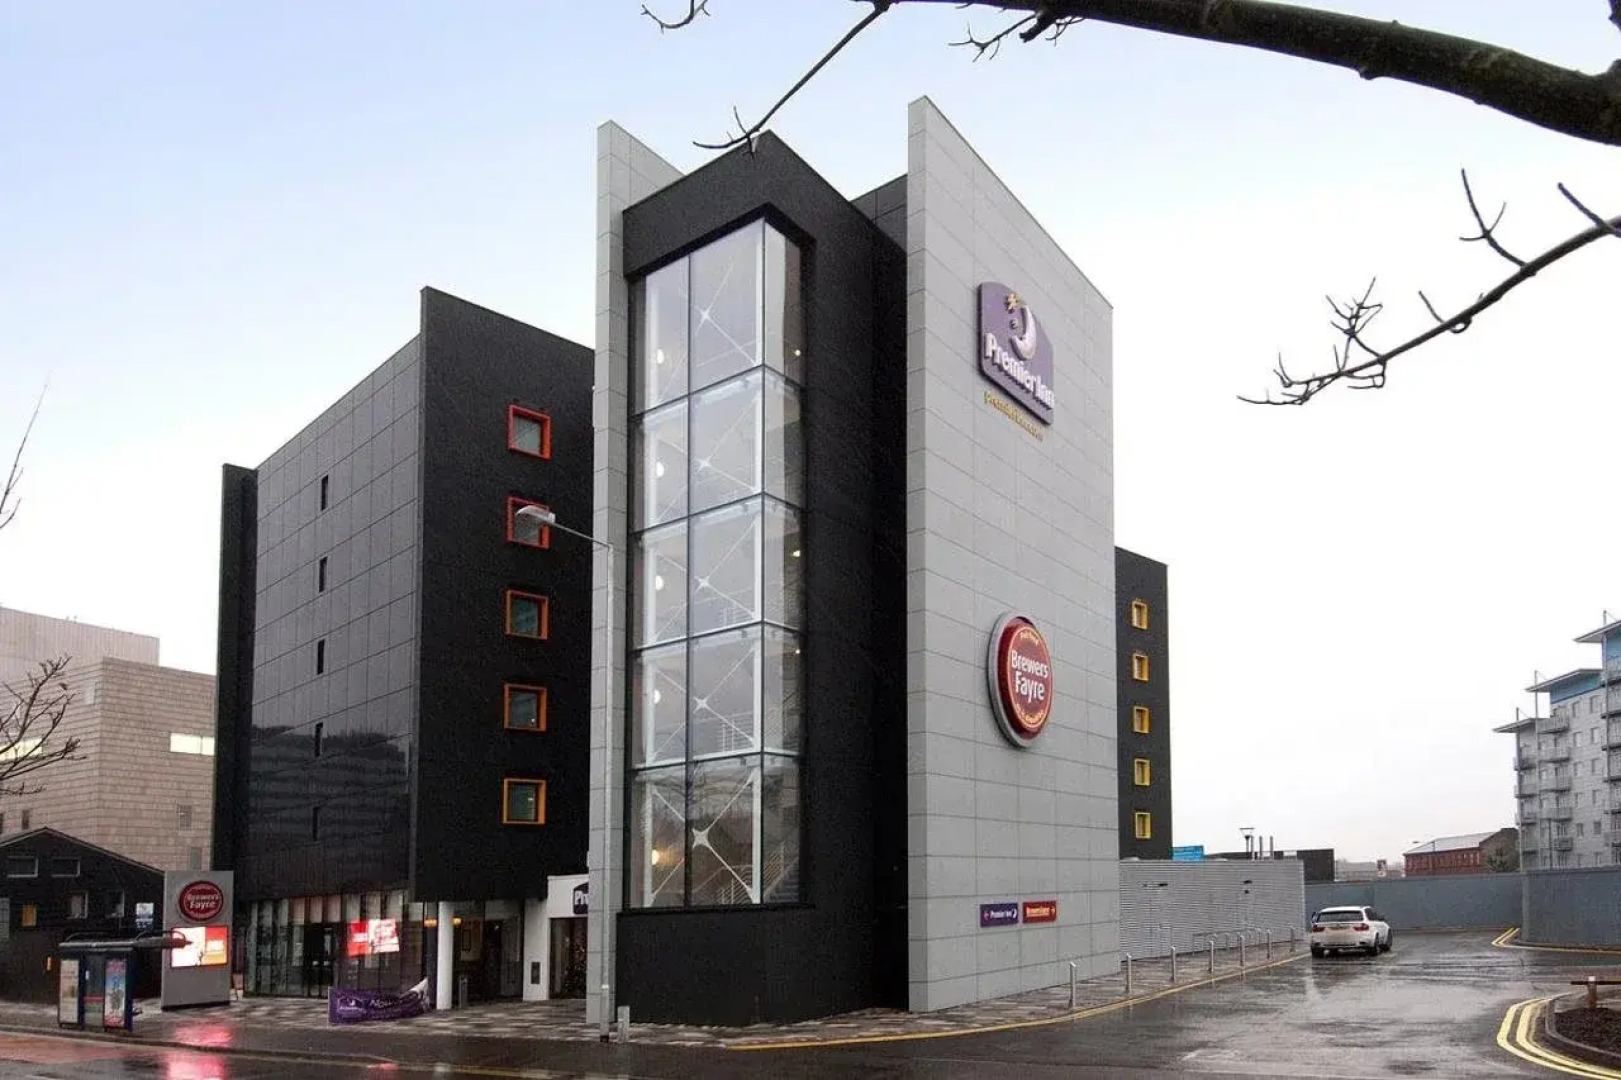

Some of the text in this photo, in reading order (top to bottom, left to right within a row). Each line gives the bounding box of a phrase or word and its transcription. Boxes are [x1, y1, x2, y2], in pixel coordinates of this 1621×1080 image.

[984, 332, 1055, 409] Premier Inn
[1011, 650, 1049, 678] Brewers
[1015, 672, 1046, 703] Fayre
[189, 900, 216, 910] Fayre
